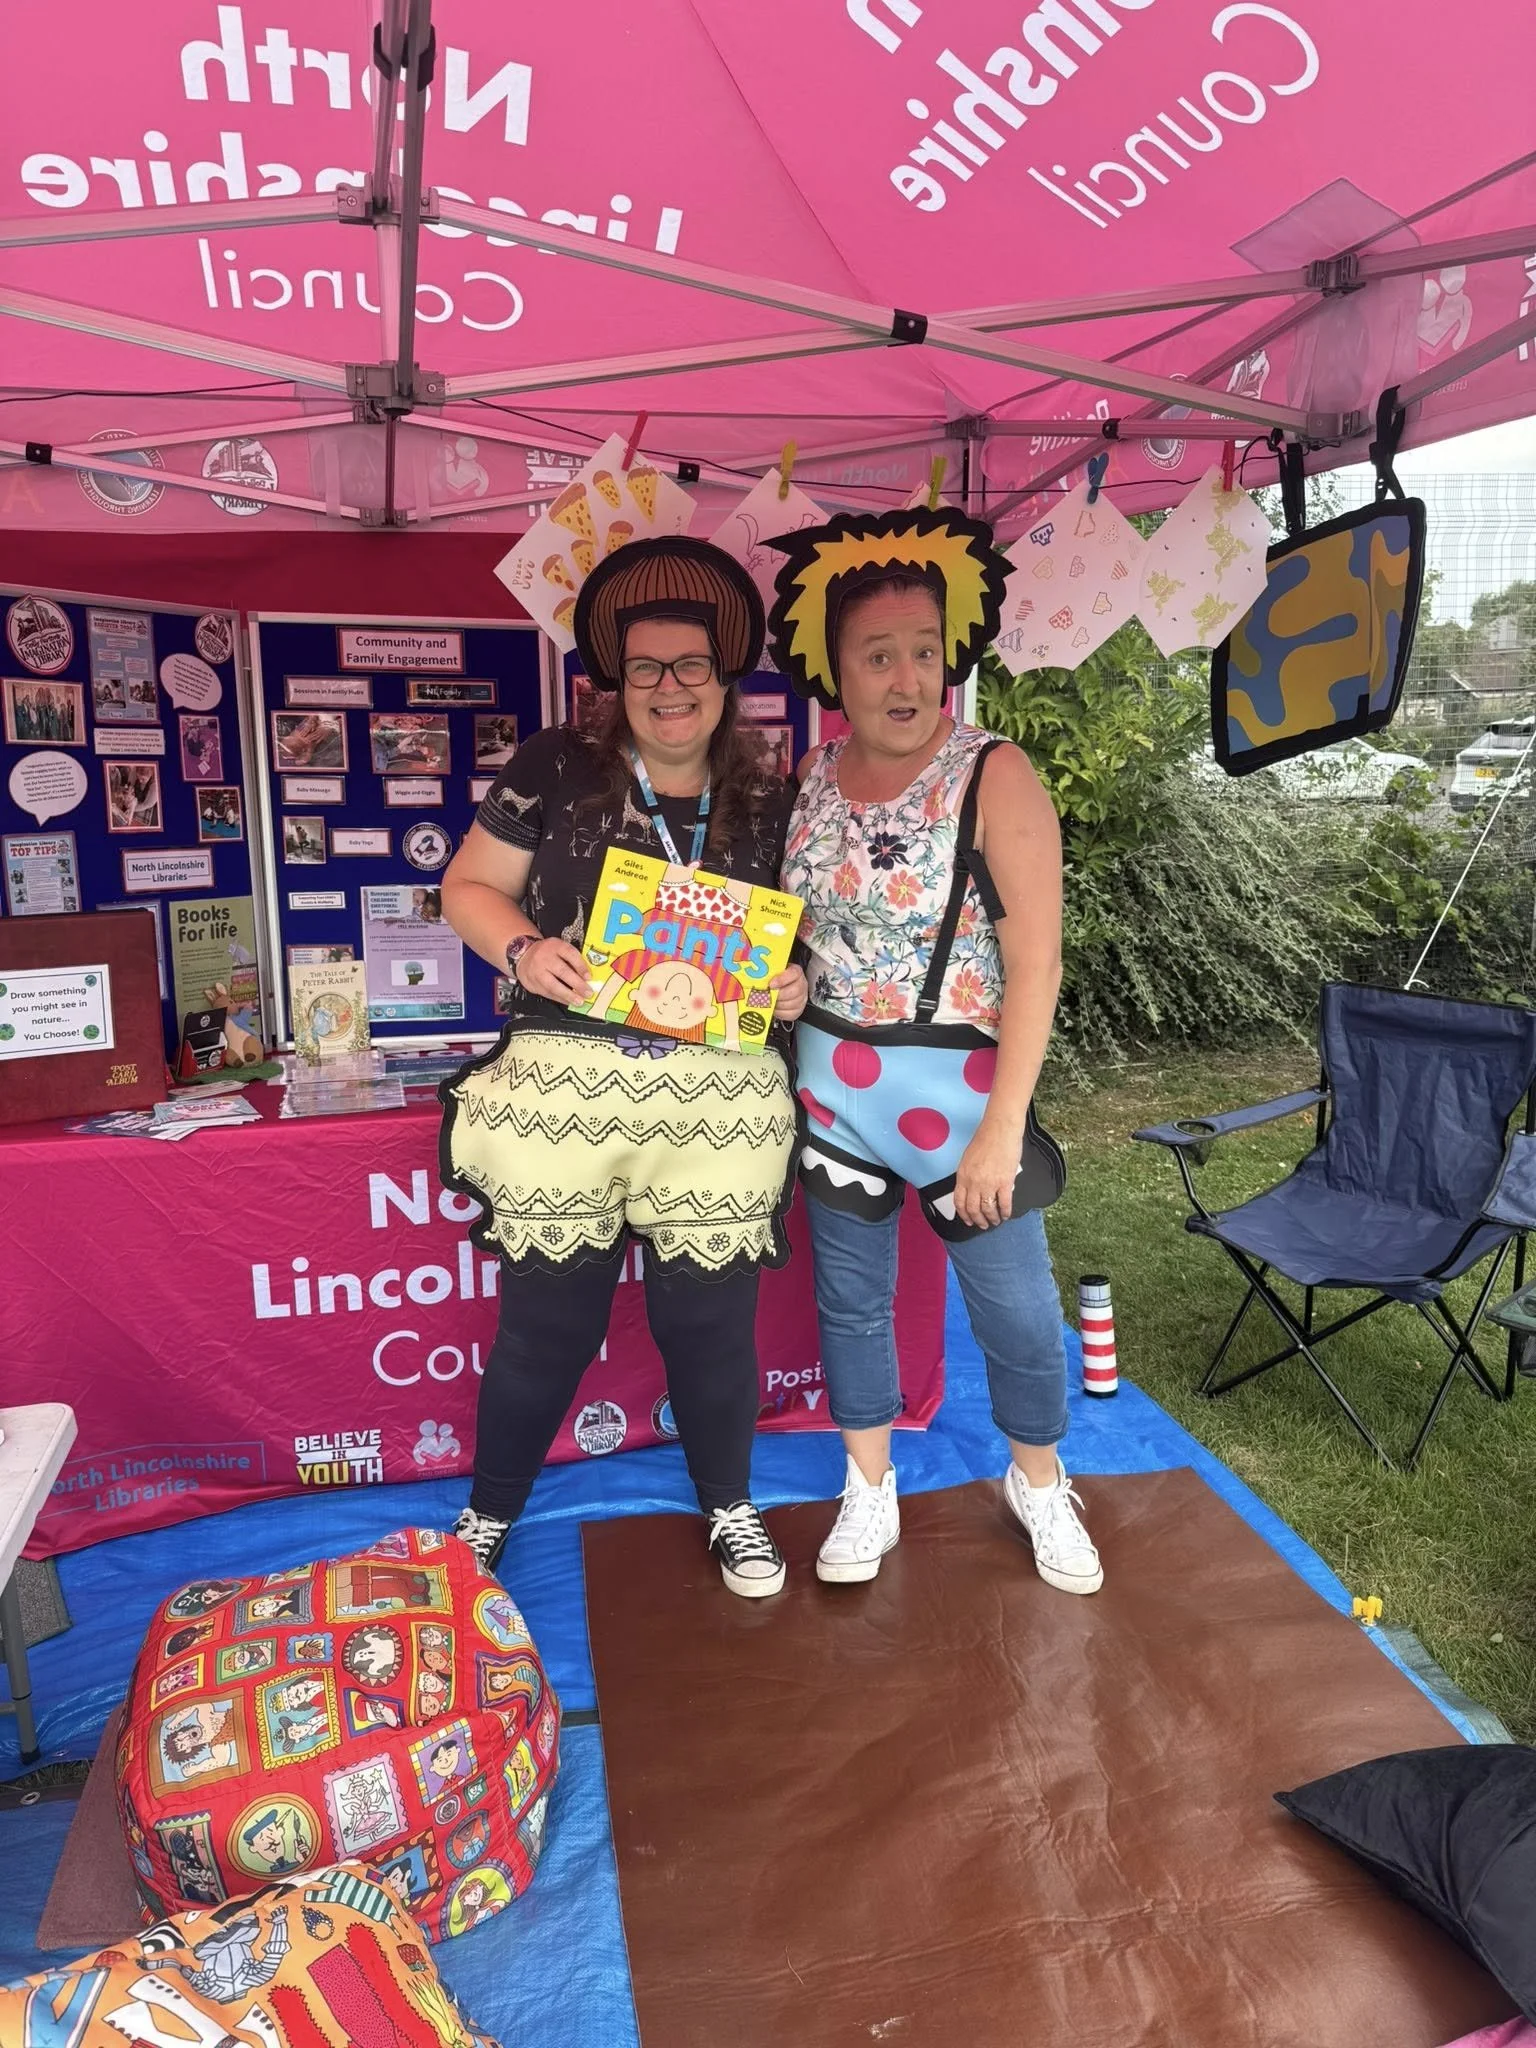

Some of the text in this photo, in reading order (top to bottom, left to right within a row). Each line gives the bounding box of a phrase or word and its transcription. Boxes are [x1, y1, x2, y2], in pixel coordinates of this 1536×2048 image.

[356, 636, 447, 650] Community and
[346, 653, 458, 668] Family Engagement
[10, 846, 57, 857] TOP TIPS
[132, 860, 205, 873] North Lincolnshire
[624, 859, 644, 871] Giles
[152, 871, 188, 883] Libraries
[615, 867, 649, 882] Andreae
[769, 898, 787, 909] Nick
[177, 905, 230, 924] Books
[179, 922, 238, 943] for life
[603, 898, 772, 979] Pants
[10, 987, 87, 1000] Draw something
[12, 1006, 29, 1014] you
[31, 1003, 58, 1012] might
[31, 1016, 70, 1025] nature...
[23, 1029, 80, 1041] You Choose!
[110, 1064, 137, 1073] POST
[112, 1070, 137, 1078] CARD
[105, 1076, 138, 1086] ALBUM
[253, 1241, 501, 1319] Lincol
[766, 1361, 825, 1392] Posi
[294, 1429, 383, 1452] BELIEVE
[50, 1453, 251, 1495] orth Lincolnshire
[296, 1458, 384, 1485] YOUTH
[95, 1478, 199, 1513] Libraries
